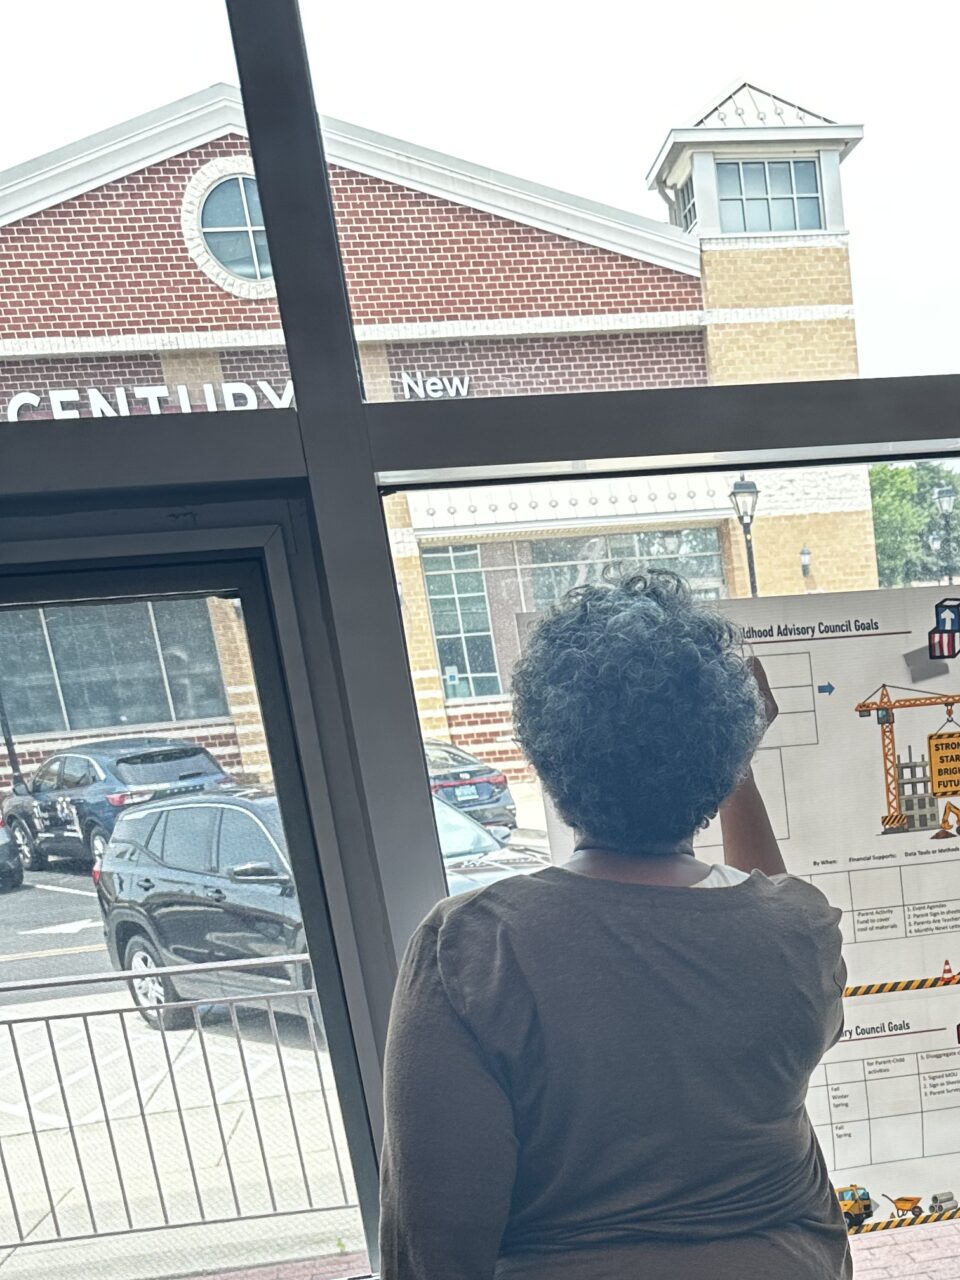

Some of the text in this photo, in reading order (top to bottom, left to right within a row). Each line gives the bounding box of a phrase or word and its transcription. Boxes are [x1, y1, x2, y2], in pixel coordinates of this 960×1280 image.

[402, 371, 470, 399] New
[777, 624, 816, 638] Advisory
[818, 620, 852, 634] Council
[854, 618, 879, 632] Goals
[849, 855, 871, 863] Financial
[855, 1022, 886, 1036] Council
[888, 1020, 911, 1031] Goals
